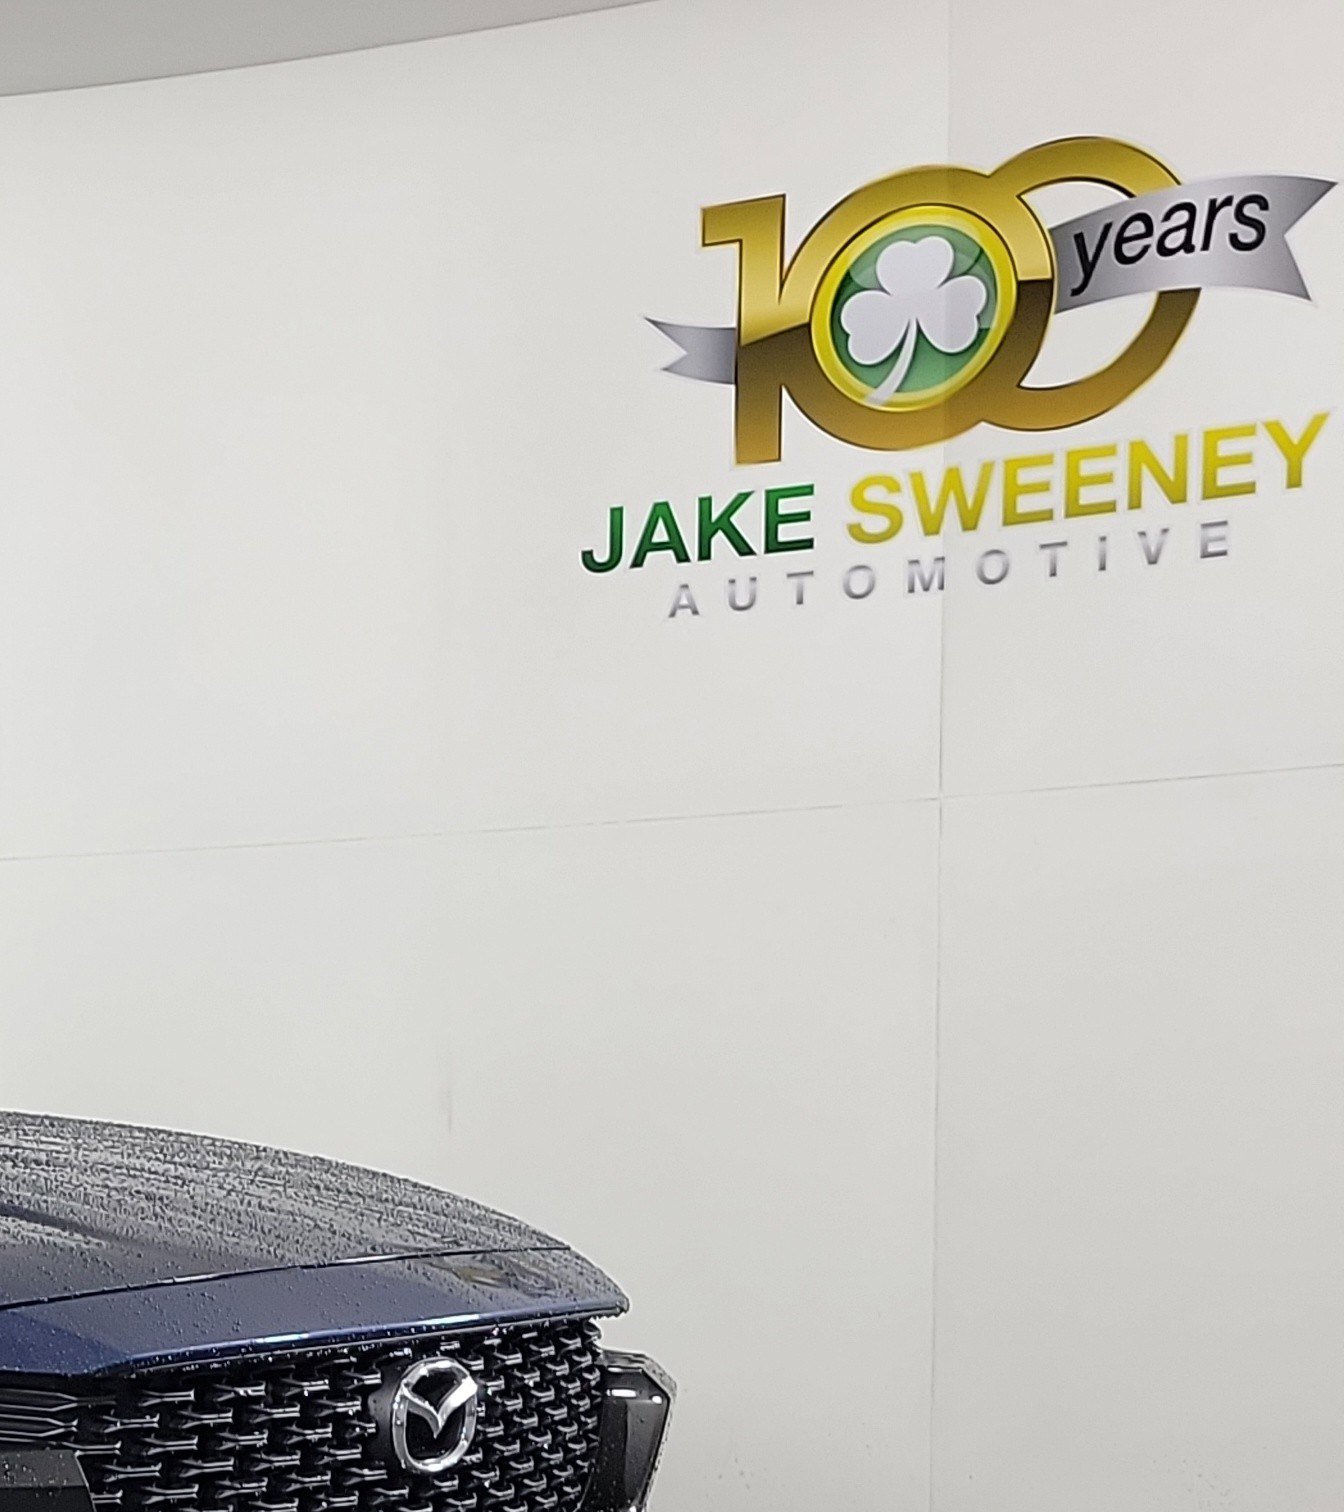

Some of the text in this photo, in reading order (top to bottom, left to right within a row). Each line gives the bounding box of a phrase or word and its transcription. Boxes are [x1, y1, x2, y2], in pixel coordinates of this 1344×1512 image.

[700, 136, 1202, 466] 100
[1070, 193, 1270, 297] years
[581, 411, 1331, 574] JAKE SWEENEY
[667, 520, 1230, 619] AUTOMOTIVE
